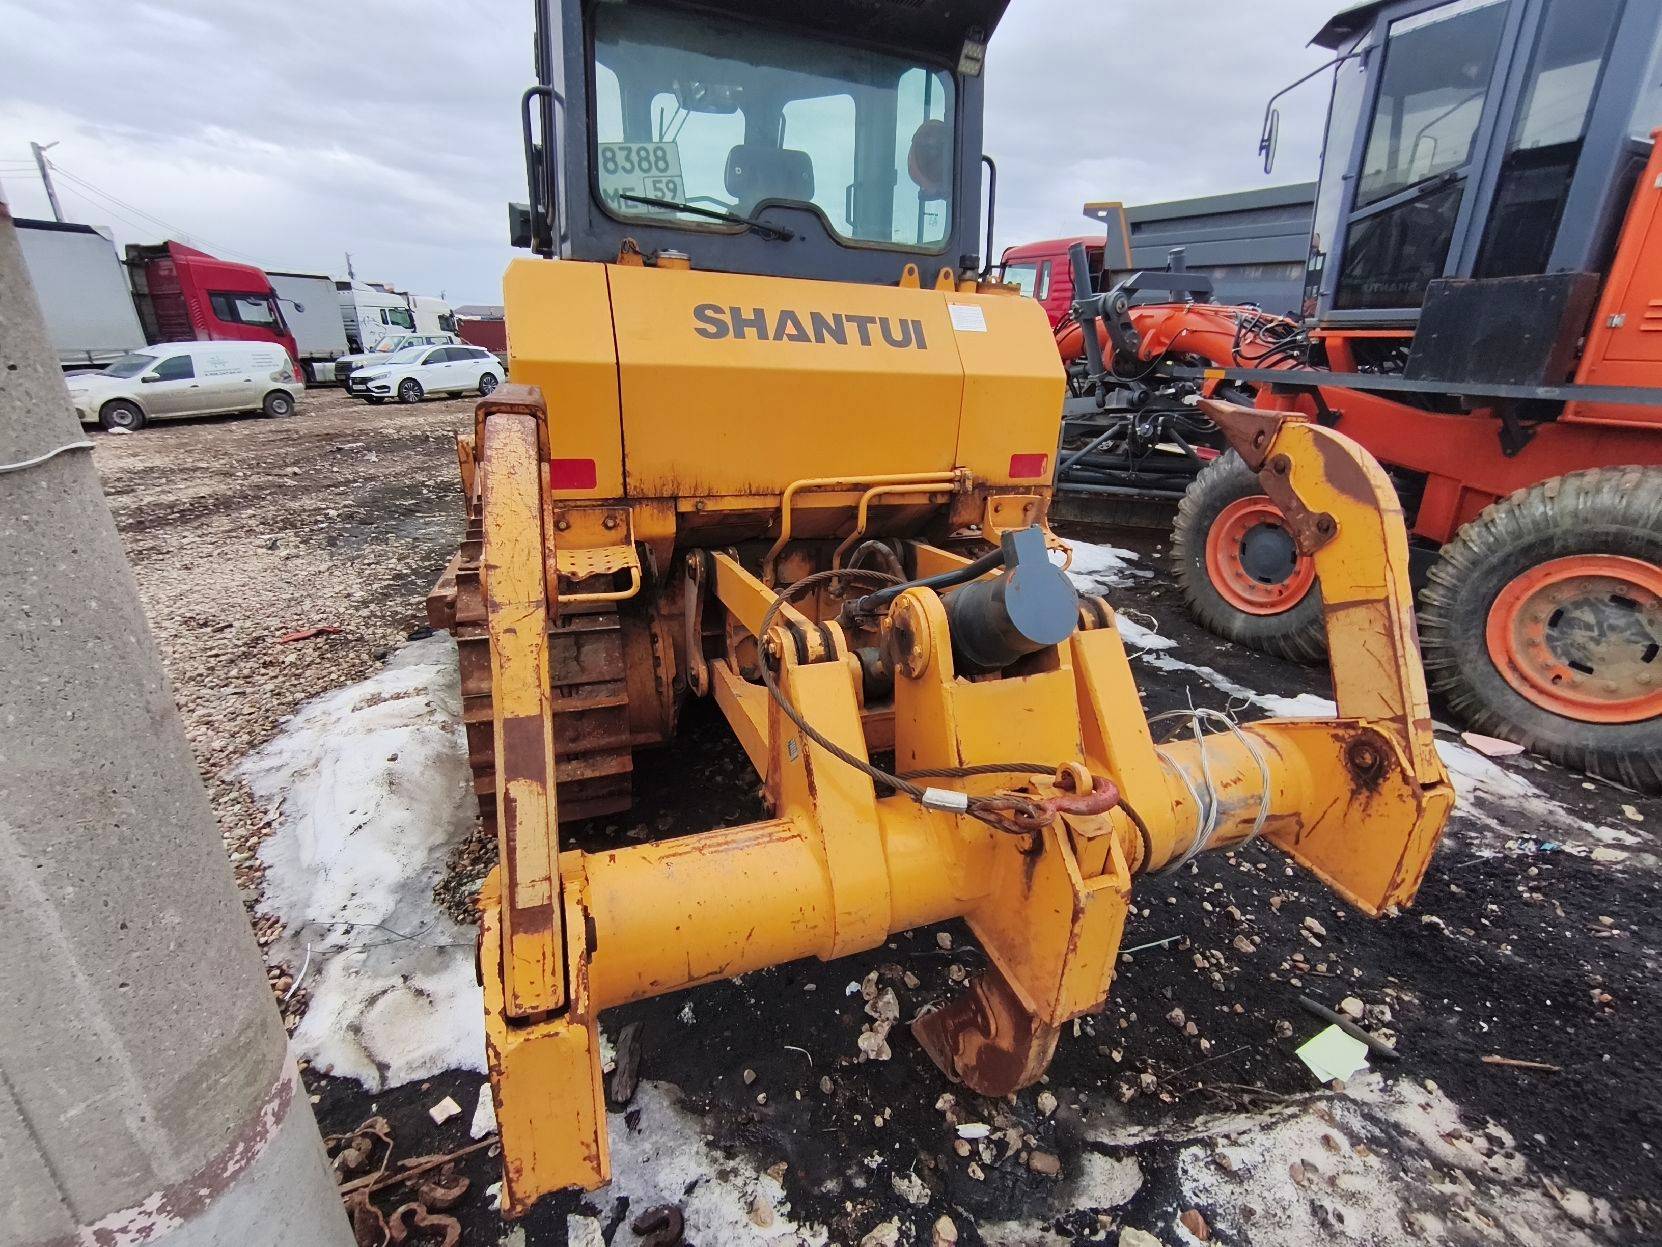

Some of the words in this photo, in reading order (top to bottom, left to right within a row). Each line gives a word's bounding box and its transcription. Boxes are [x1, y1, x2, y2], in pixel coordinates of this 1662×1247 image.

[601, 145, 670, 175] 8388
[652, 180, 678, 201] 59
[693, 303, 928, 349] SHANTUI
